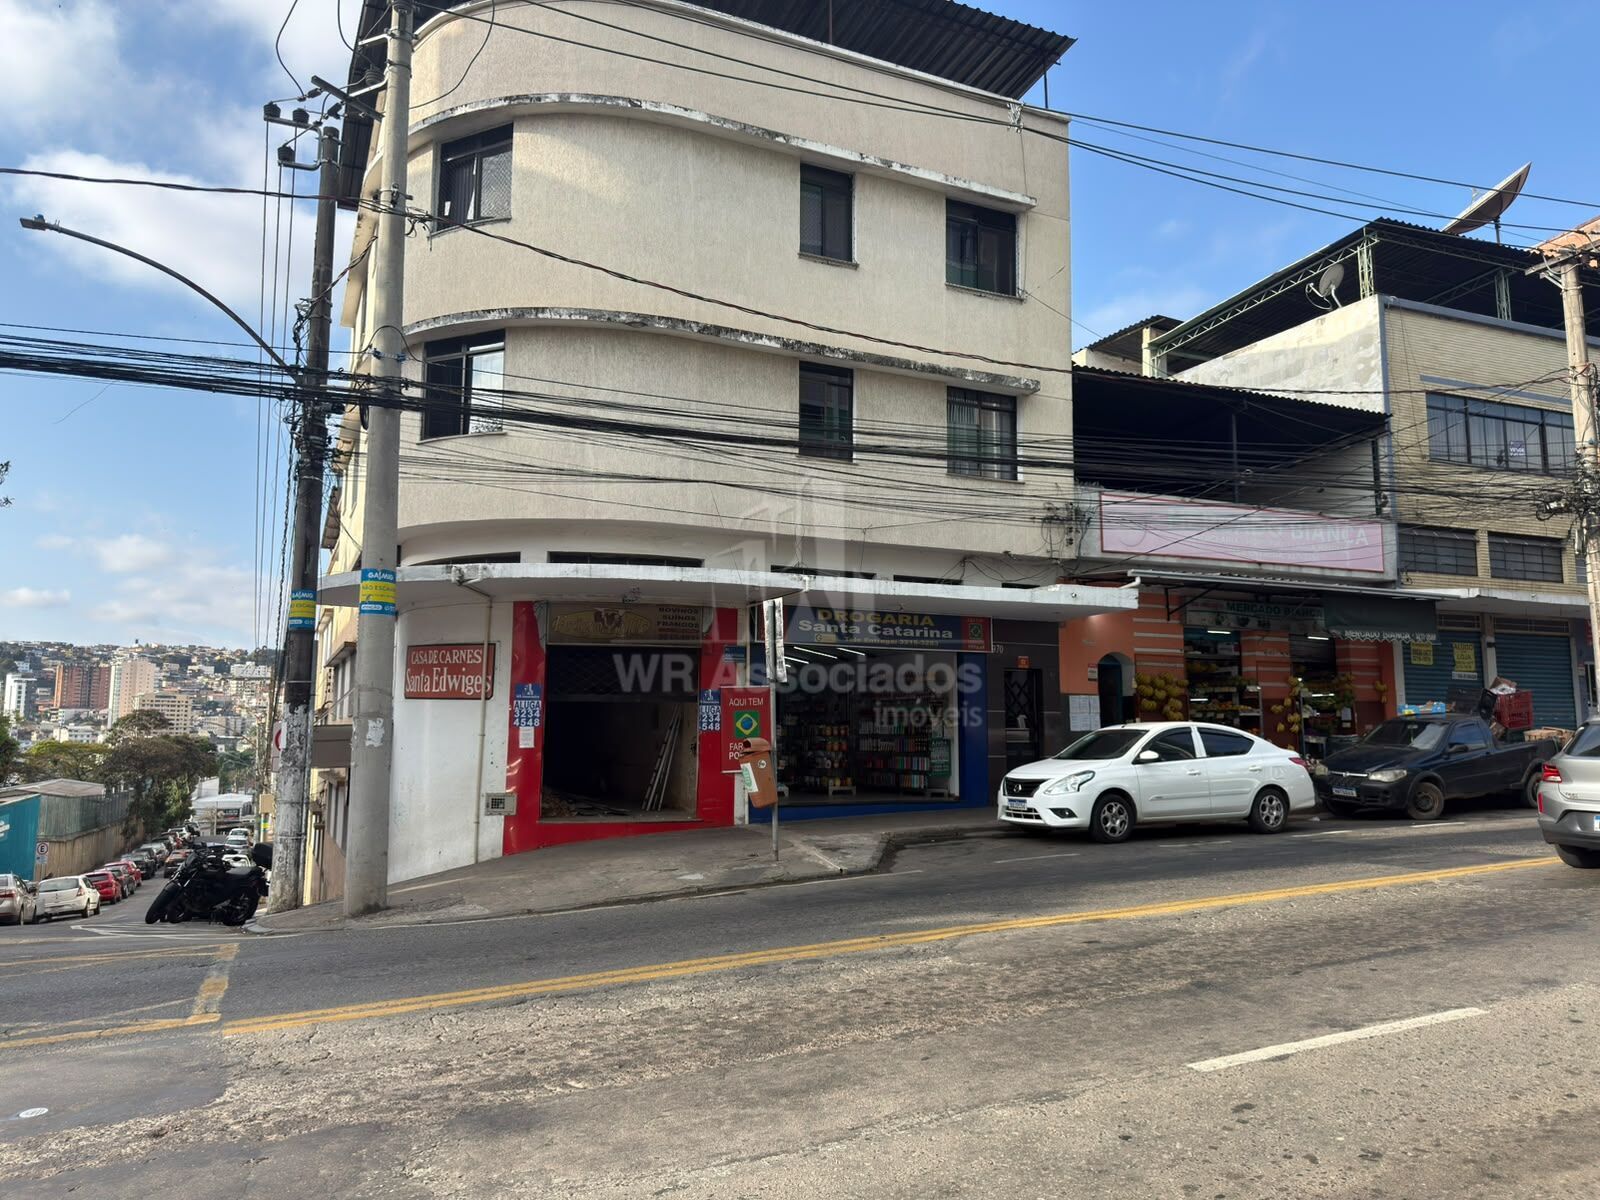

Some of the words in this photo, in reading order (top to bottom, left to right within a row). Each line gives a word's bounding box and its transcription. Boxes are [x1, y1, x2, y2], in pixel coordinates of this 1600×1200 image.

[817, 609, 935, 627] DROGARIA
[798, 619, 861, 635] Santa
[867, 624, 953, 639] Catarina
[411, 651, 428, 664] CASA
[428, 650, 439, 664] DE
[439, 649, 482, 664] CARNES
[405, 668, 430, 692] Santa
[432, 667, 492, 695] Edwiges
[513, 700, 542, 709] ALUGA
[728, 698, 747, 707] AQUI
[749, 698, 764, 706] TEM
[514, 709, 540, 718] 3234
[513, 718, 540, 727] 4548
[699, 714, 721, 723] 234
[699, 722, 721, 731] 548
[729, 743, 744, 751] FAR
[728, 752, 744, 760] PO
[40, 845, 45, 853] E
